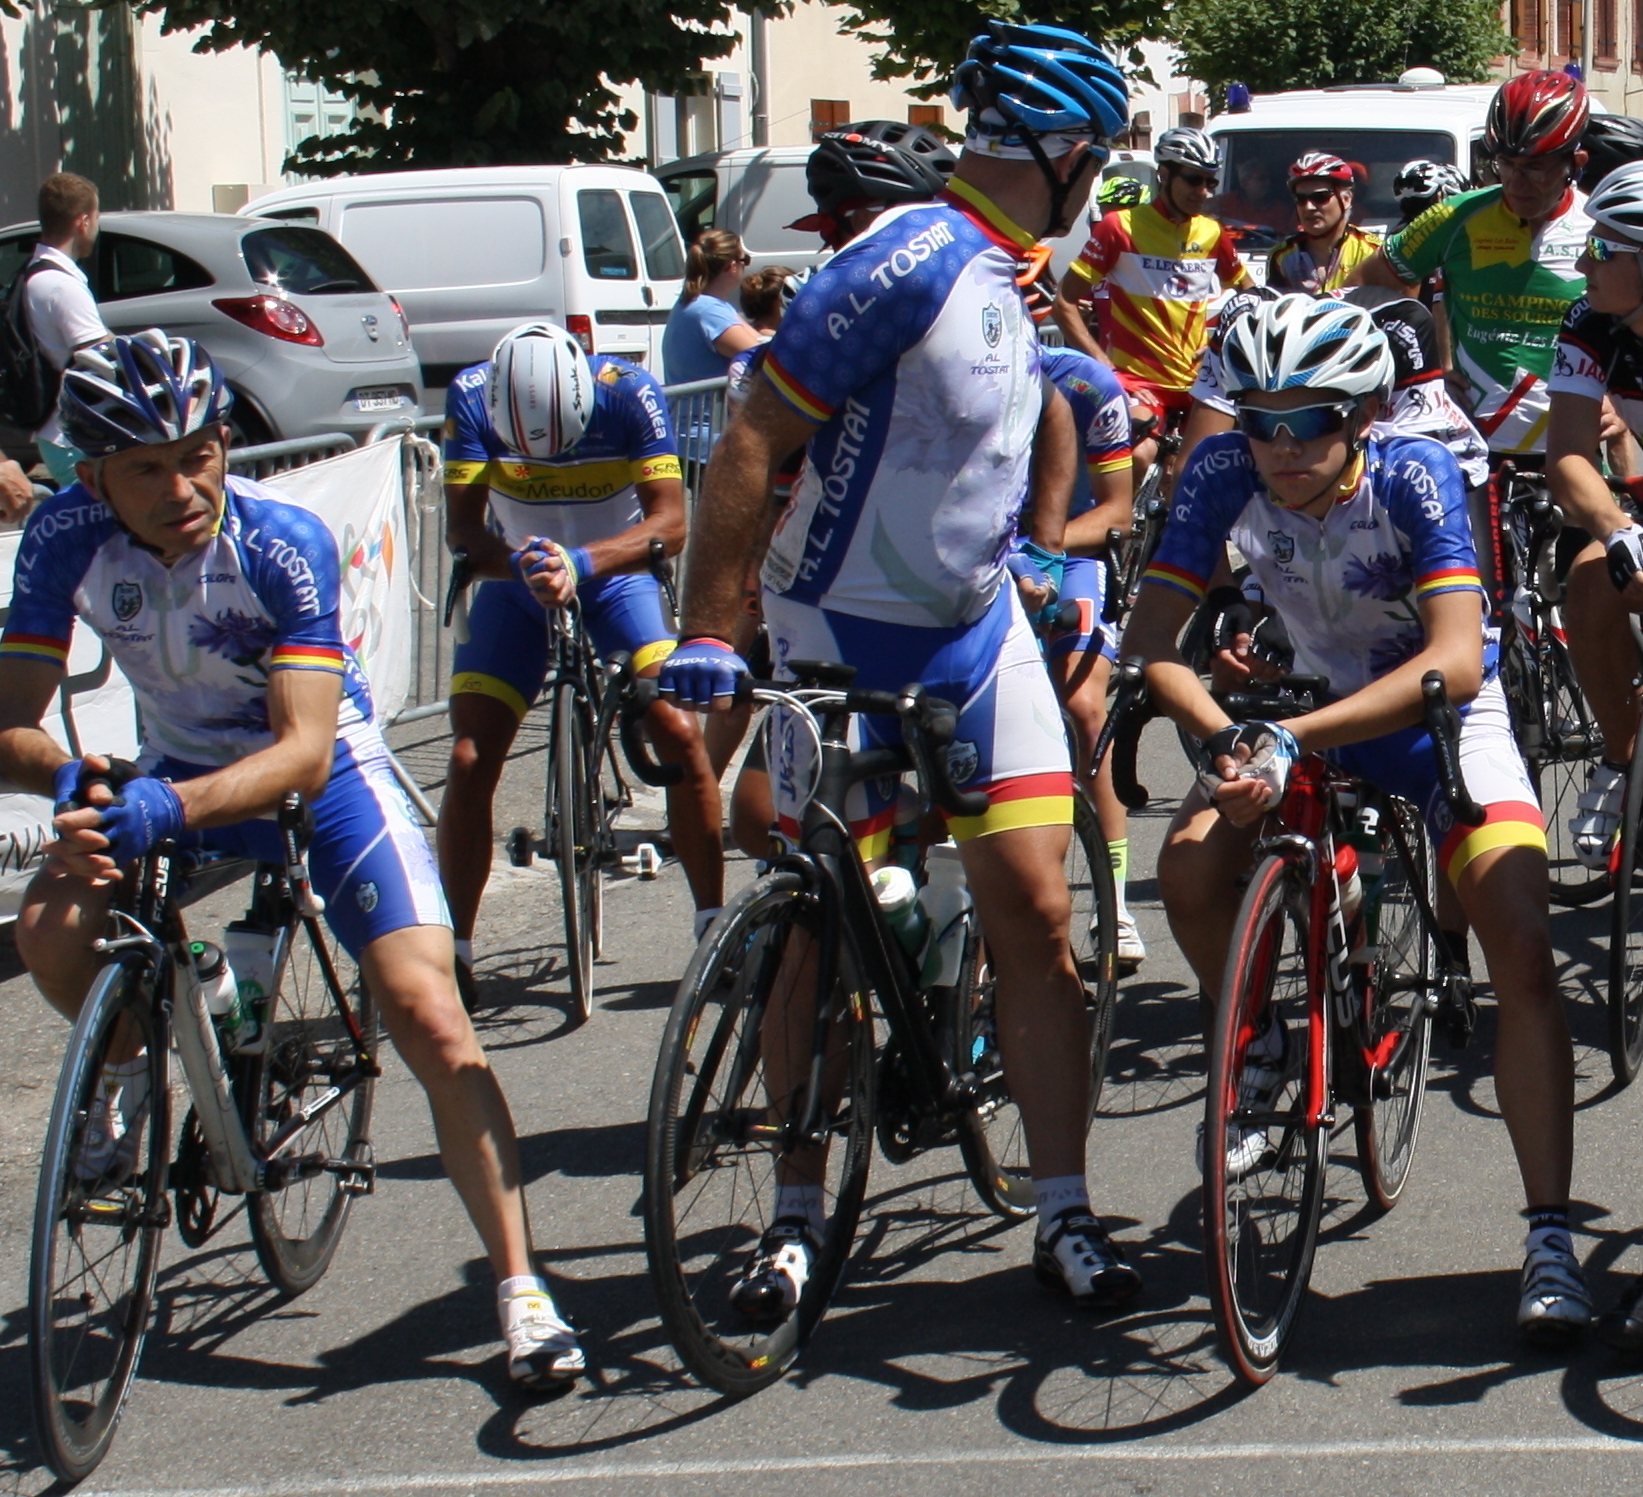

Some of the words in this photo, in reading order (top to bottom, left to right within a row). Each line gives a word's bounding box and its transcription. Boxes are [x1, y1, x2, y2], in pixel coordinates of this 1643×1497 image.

[869, 221, 956, 290] TOSTAT
[1472, 307, 1499, 320] DES
[1503, 308, 1562, 325] SOURC
[970, 364, 1011, 376] TOSTAT
[820, 399, 871, 517] TOSTAT
[526, 481, 615, 500] Meudon
[30, 503, 113, 543] TOSTA
[269, 537, 322, 617] TOSTAT
